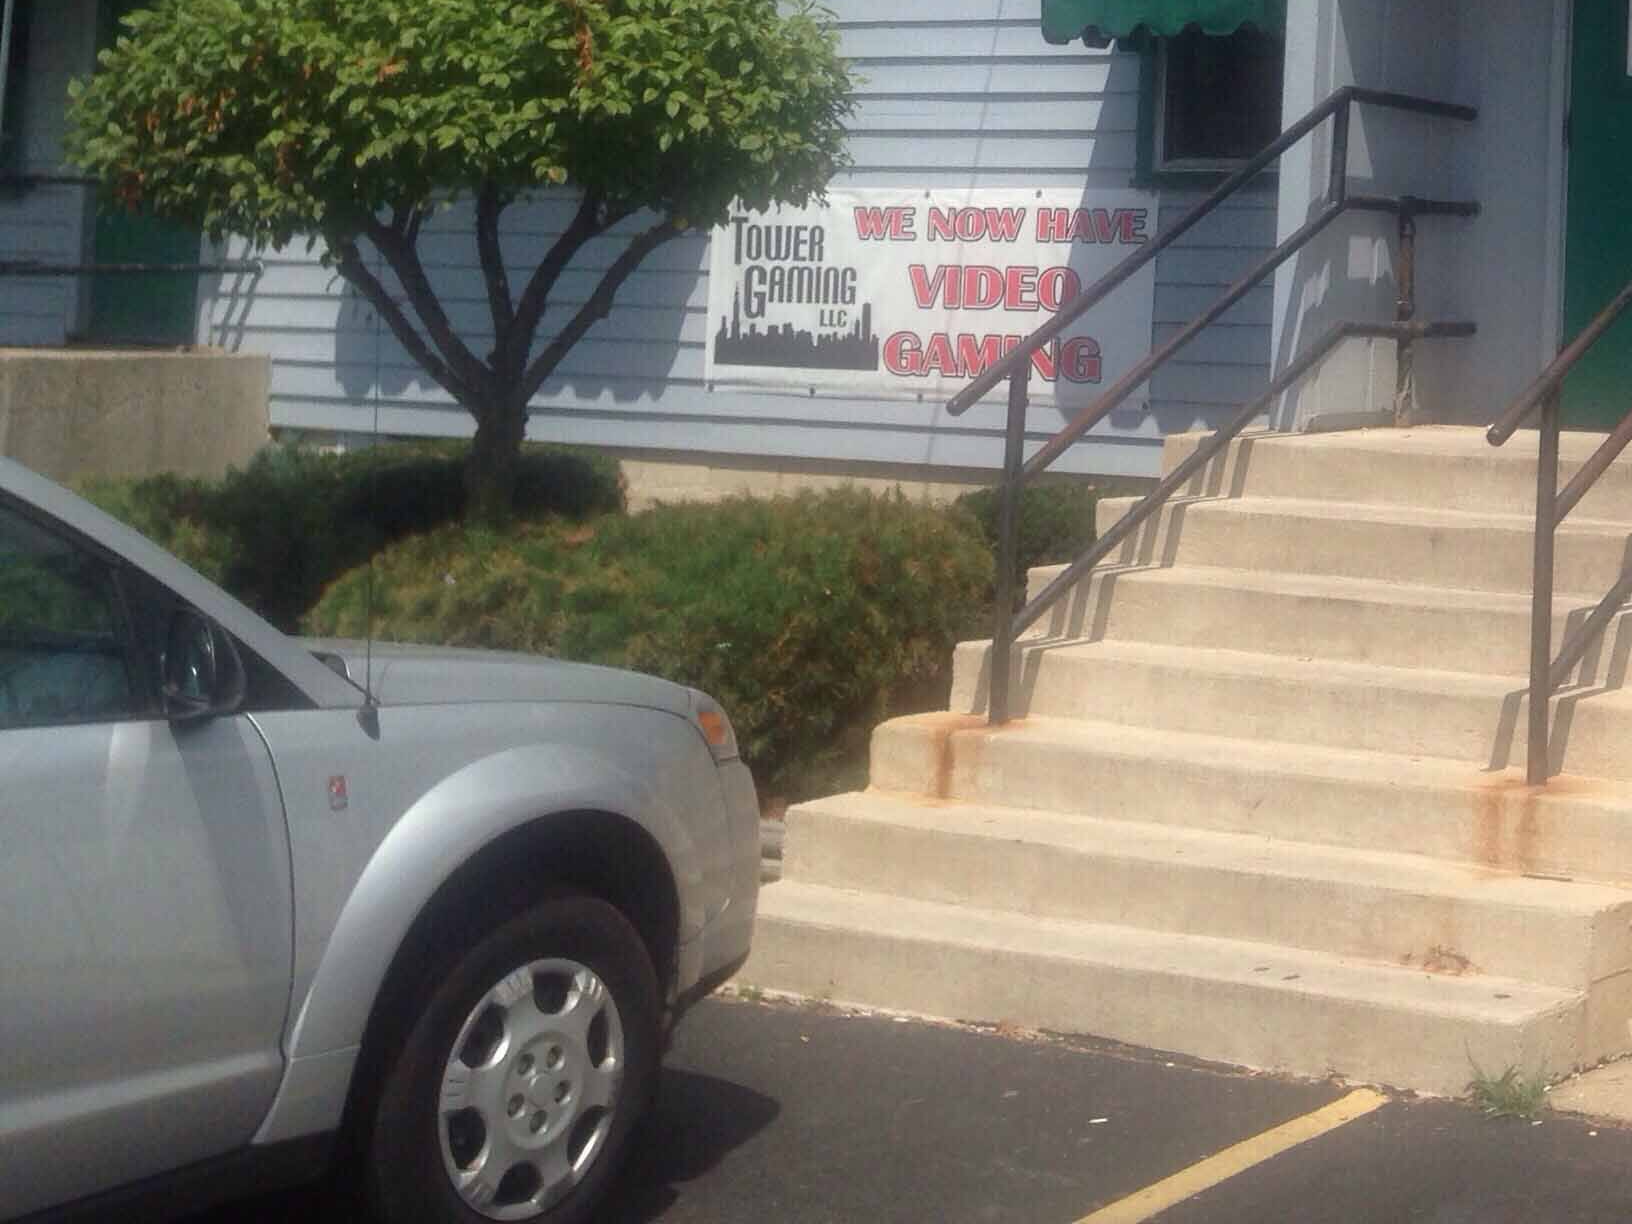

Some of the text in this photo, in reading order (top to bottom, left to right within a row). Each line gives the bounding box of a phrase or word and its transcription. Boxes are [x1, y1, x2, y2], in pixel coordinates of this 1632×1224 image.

[731, 216, 825, 265] TOWER
[853, 207, 1150, 244] WE NOW HAVE
[908, 264, 1082, 312] VIDEO
[819, 309, 848, 328] LLC
